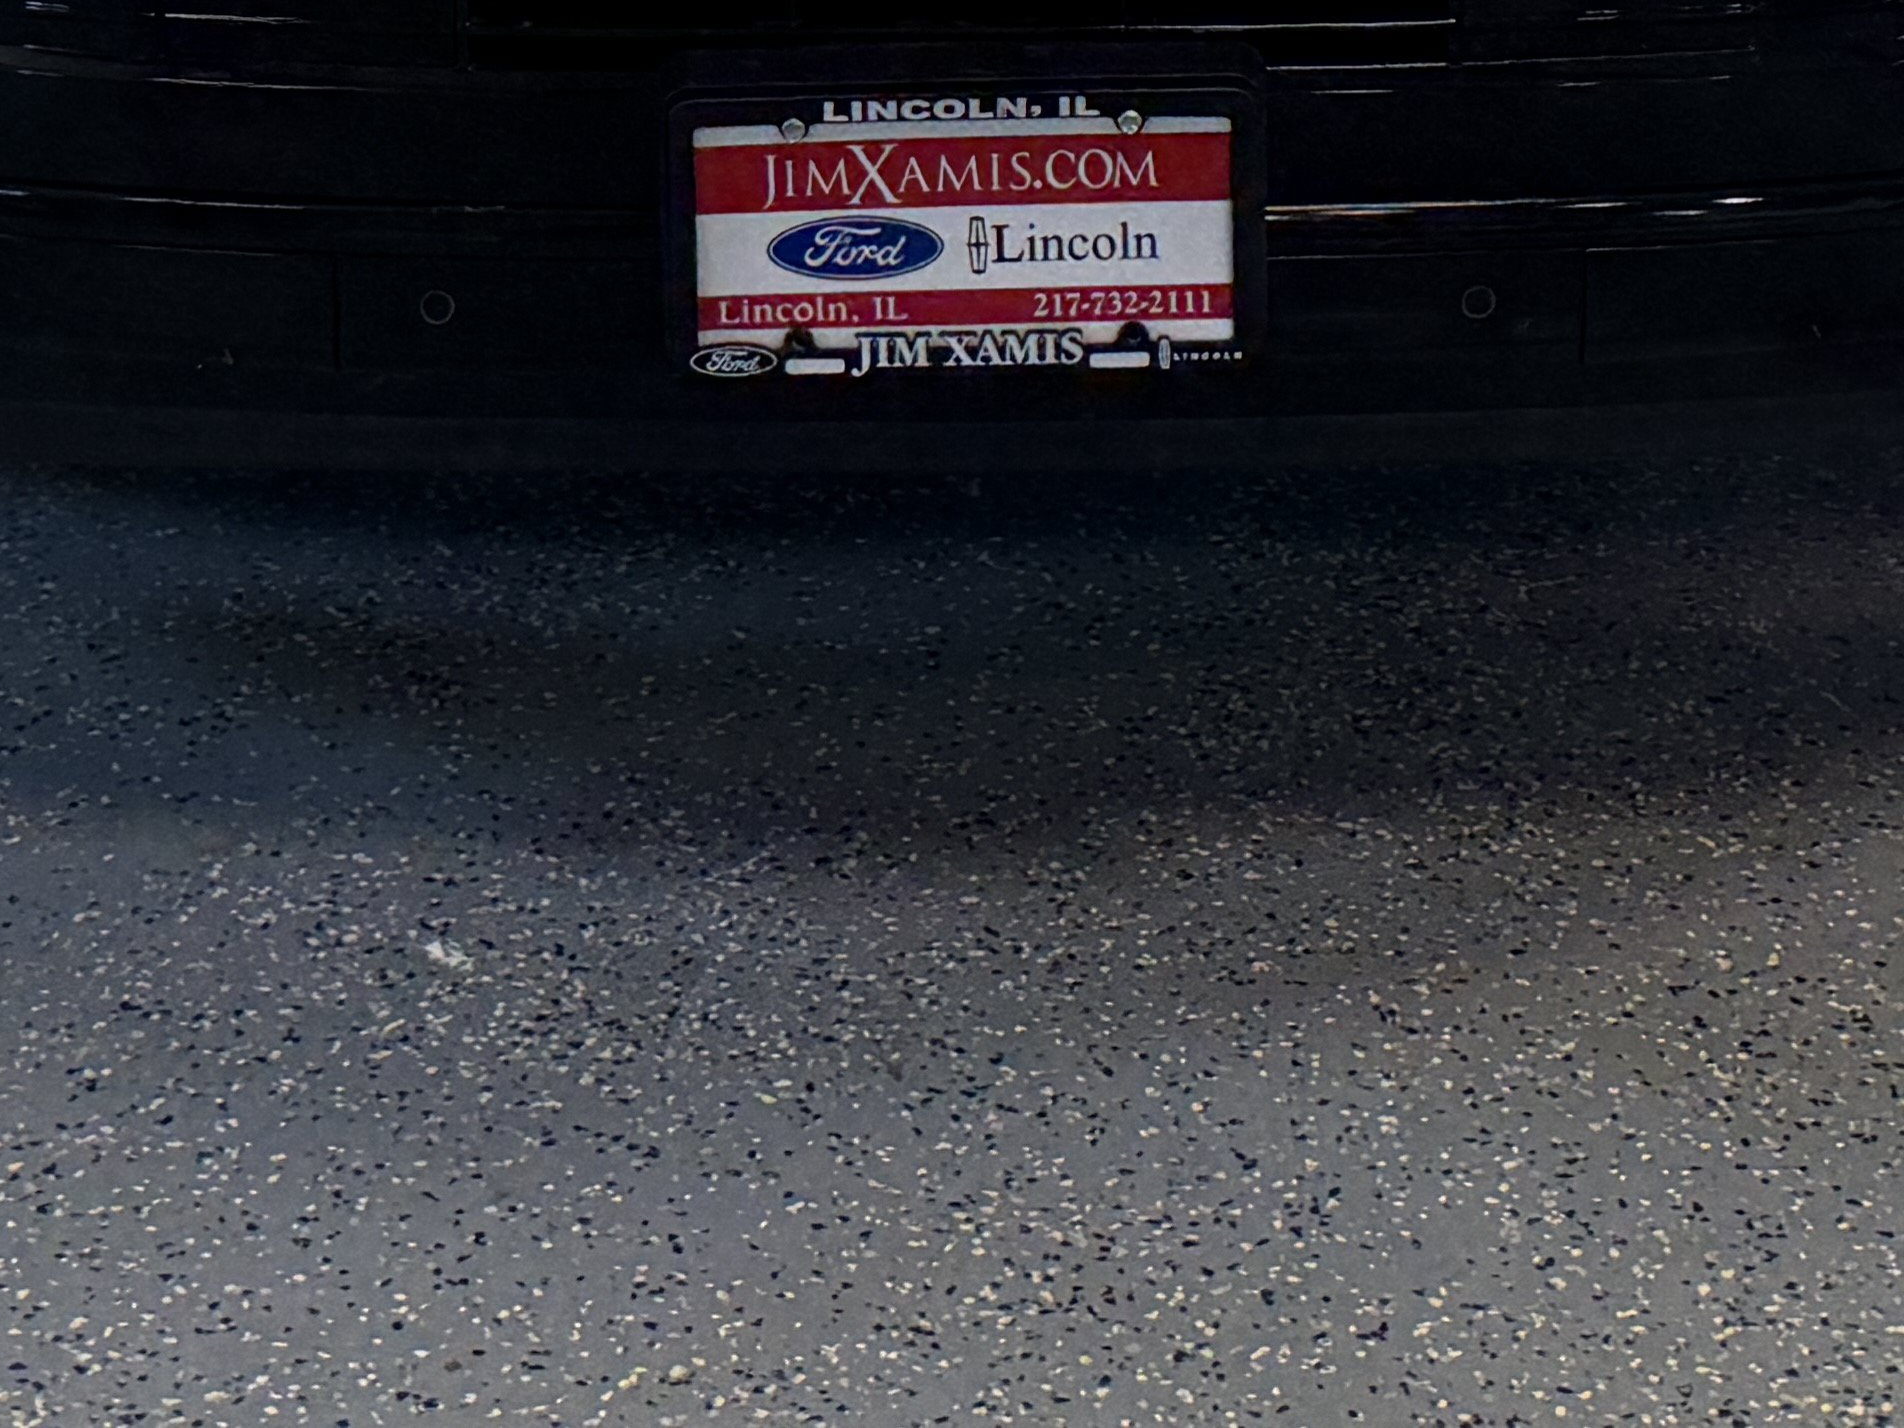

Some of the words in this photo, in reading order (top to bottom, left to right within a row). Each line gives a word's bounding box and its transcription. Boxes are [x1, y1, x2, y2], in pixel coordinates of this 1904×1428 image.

[822, 97, 1042, 122] LINCOLN,
[1058, 95, 1100, 117] IL
[803, 225, 906, 268] Ford
[991, 221, 1159, 263] Lincoln
[718, 296, 860, 324] Lincoln,
[872, 296, 908, 321] IL
[1033, 290, 1211, 318] 217-732-2111
[705, 350, 761, 372] Ford
[851, 332, 931, 378] JIM
[942, 328, 1085, 367] XAMIS
